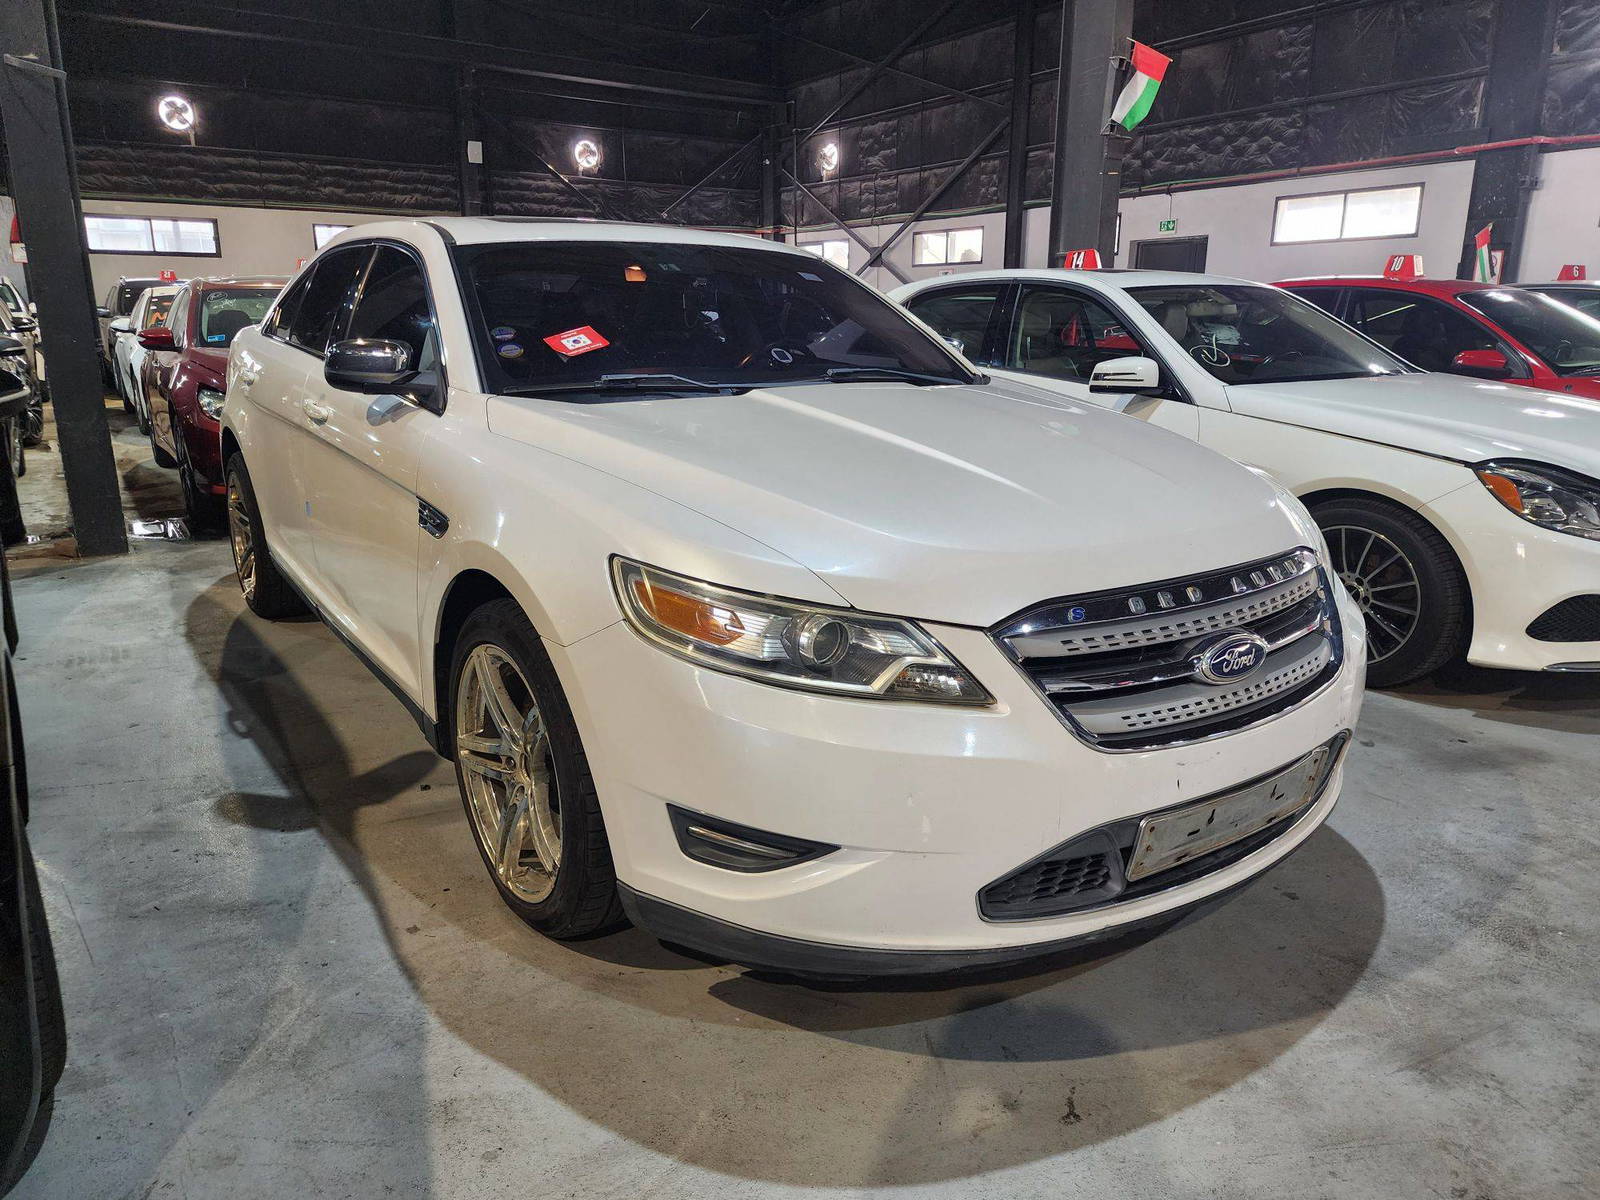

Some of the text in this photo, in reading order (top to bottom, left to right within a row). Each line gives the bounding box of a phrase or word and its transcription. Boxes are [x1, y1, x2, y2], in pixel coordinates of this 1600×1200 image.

[1071, 251, 1085, 269] 14
[1390, 255, 1404, 271] 10
[1573, 265, 1579, 278] 6
[1211, 644, 1256, 673] Ford
